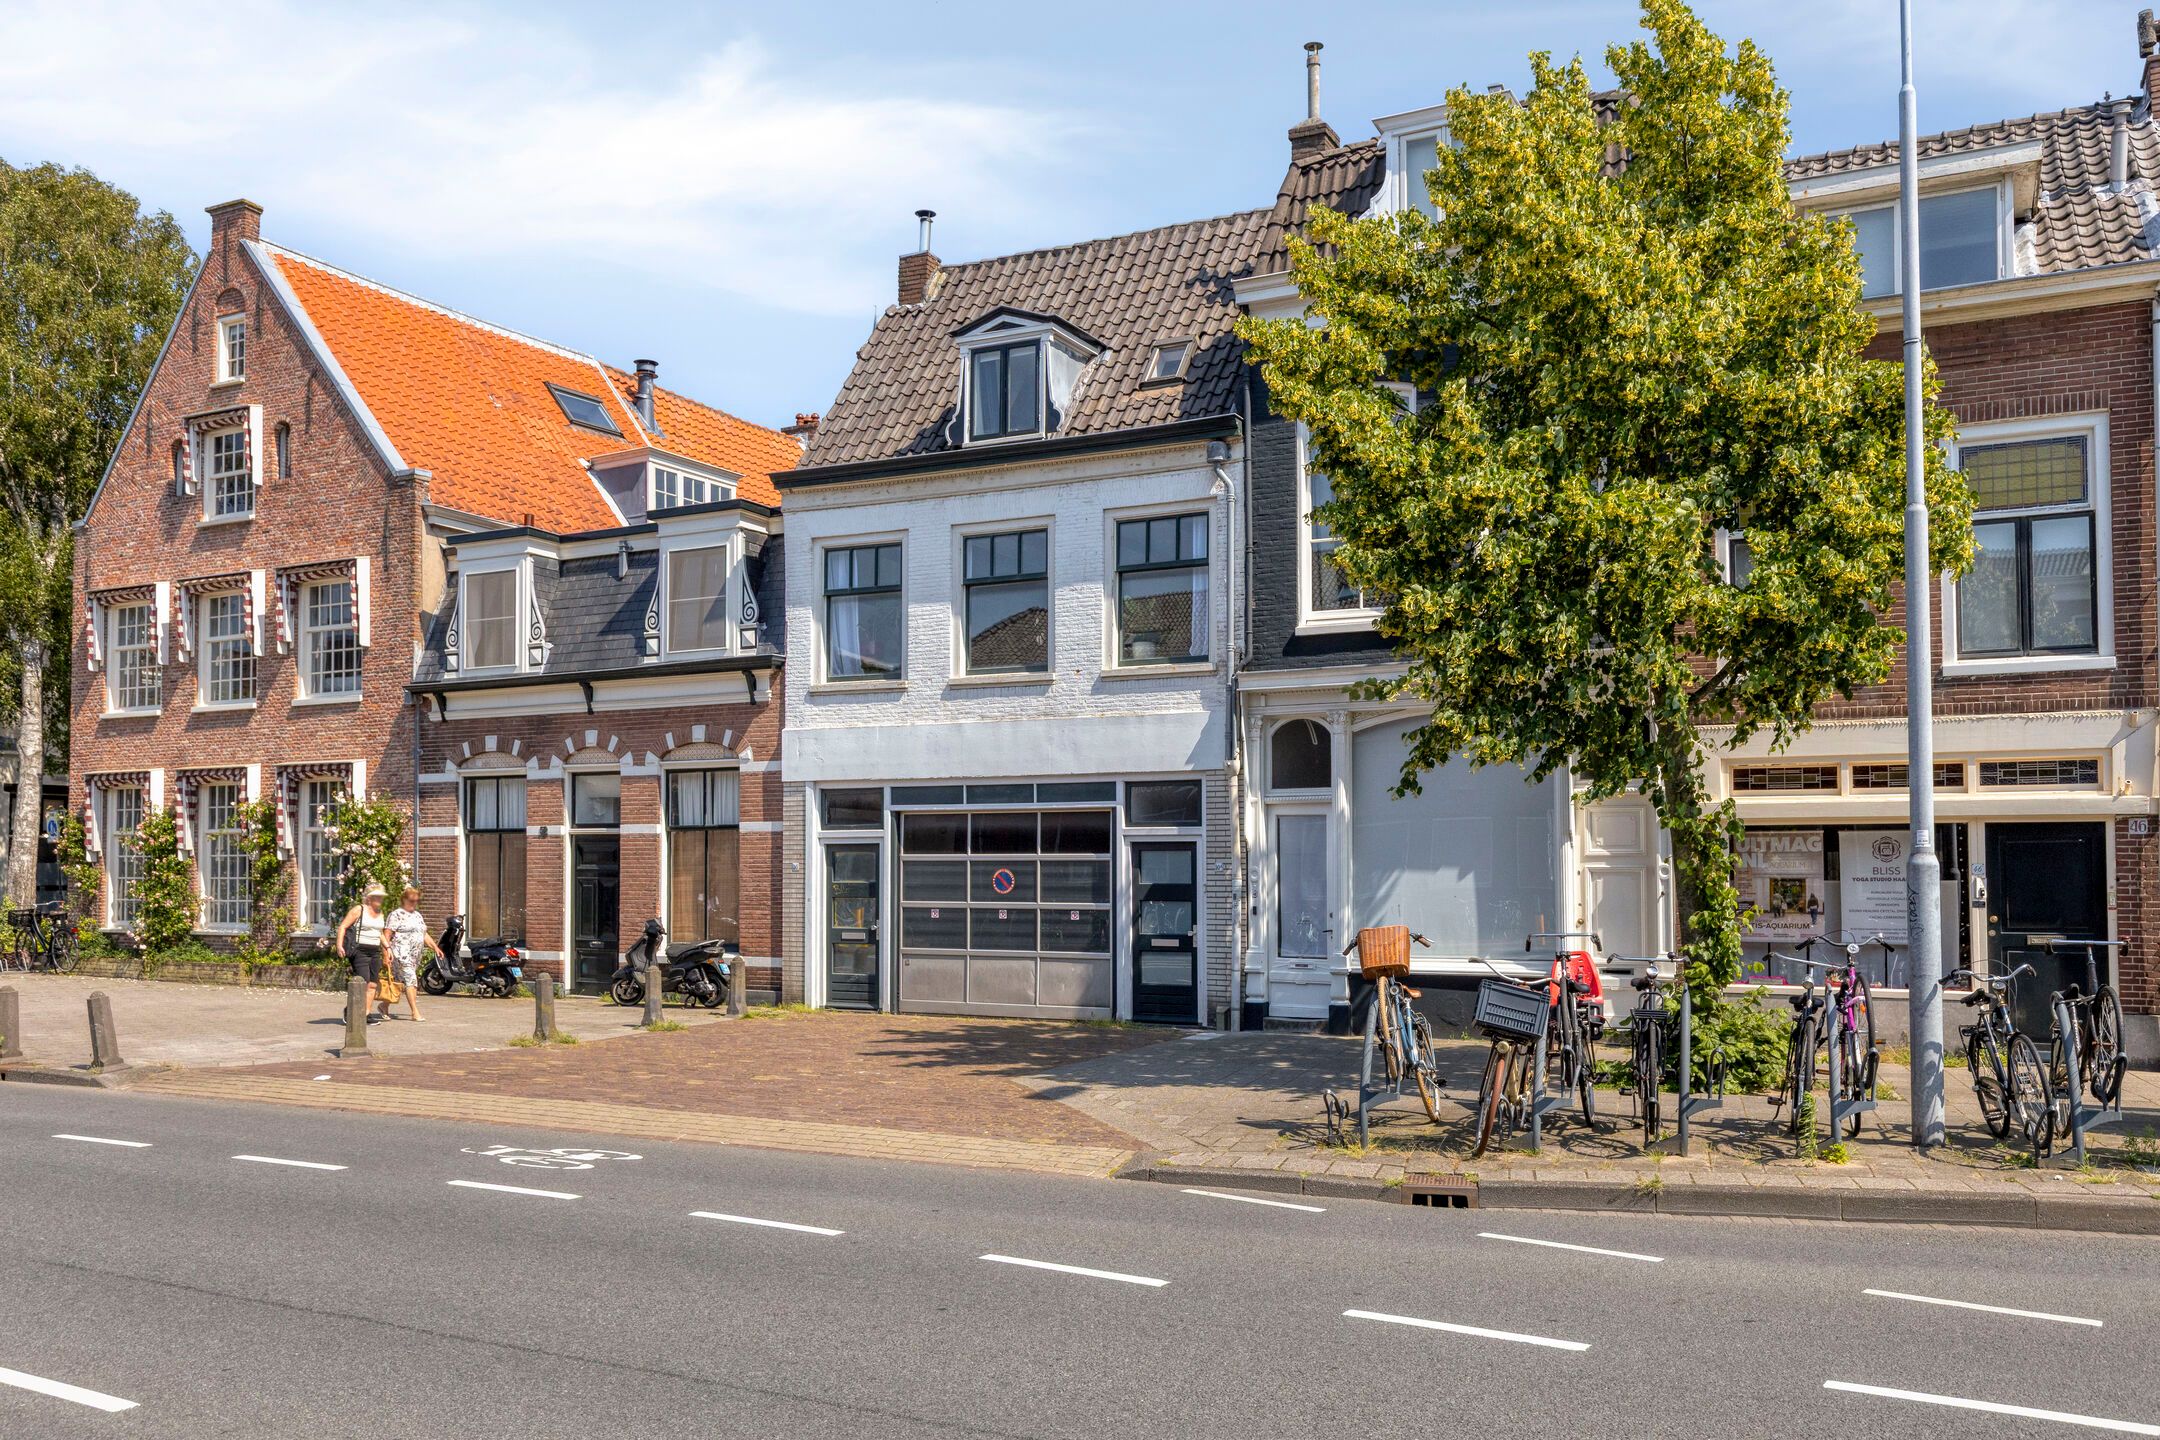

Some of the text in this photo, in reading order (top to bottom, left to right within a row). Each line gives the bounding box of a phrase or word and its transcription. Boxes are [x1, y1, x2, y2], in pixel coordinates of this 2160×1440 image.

[2129, 820, 2147, 833] 46
[1735, 836, 1822, 852] UITMAG
[1872, 866, 1901, 875] BLISS
[1973, 865, 1983, 873] 46
